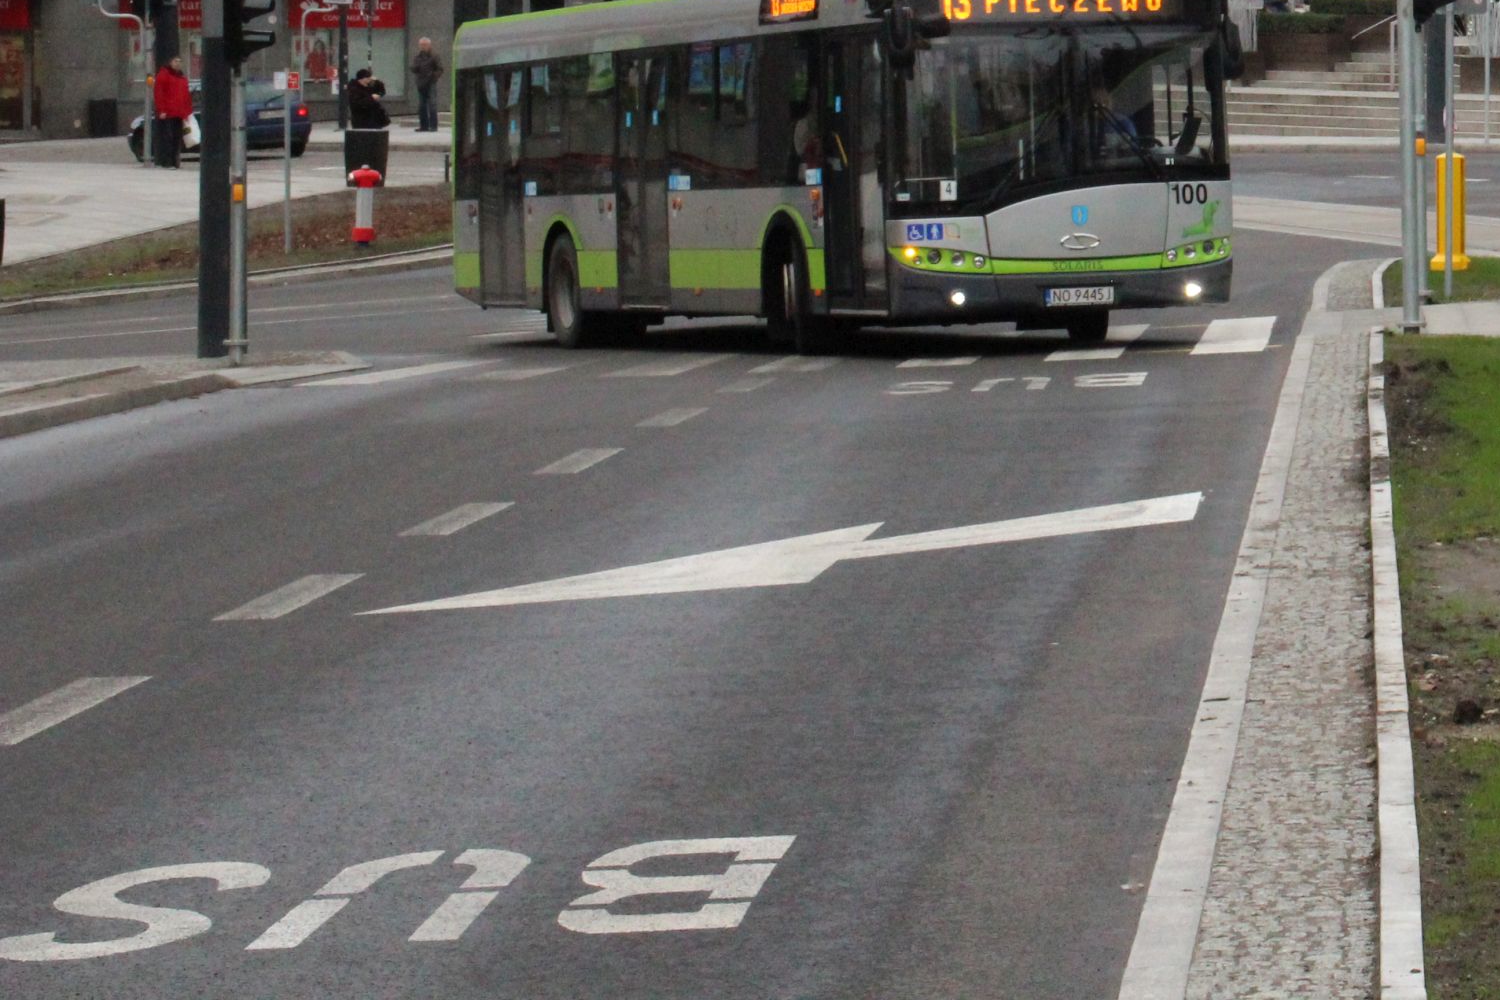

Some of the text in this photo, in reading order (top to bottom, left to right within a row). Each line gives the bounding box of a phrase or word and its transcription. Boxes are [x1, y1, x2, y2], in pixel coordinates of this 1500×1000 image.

[945, 182, 952, 196] 4
[1171, 183, 1208, 204] 100
[1052, 260, 1104, 271] SOLARIS
[0, 834, 798, 963] BUS
